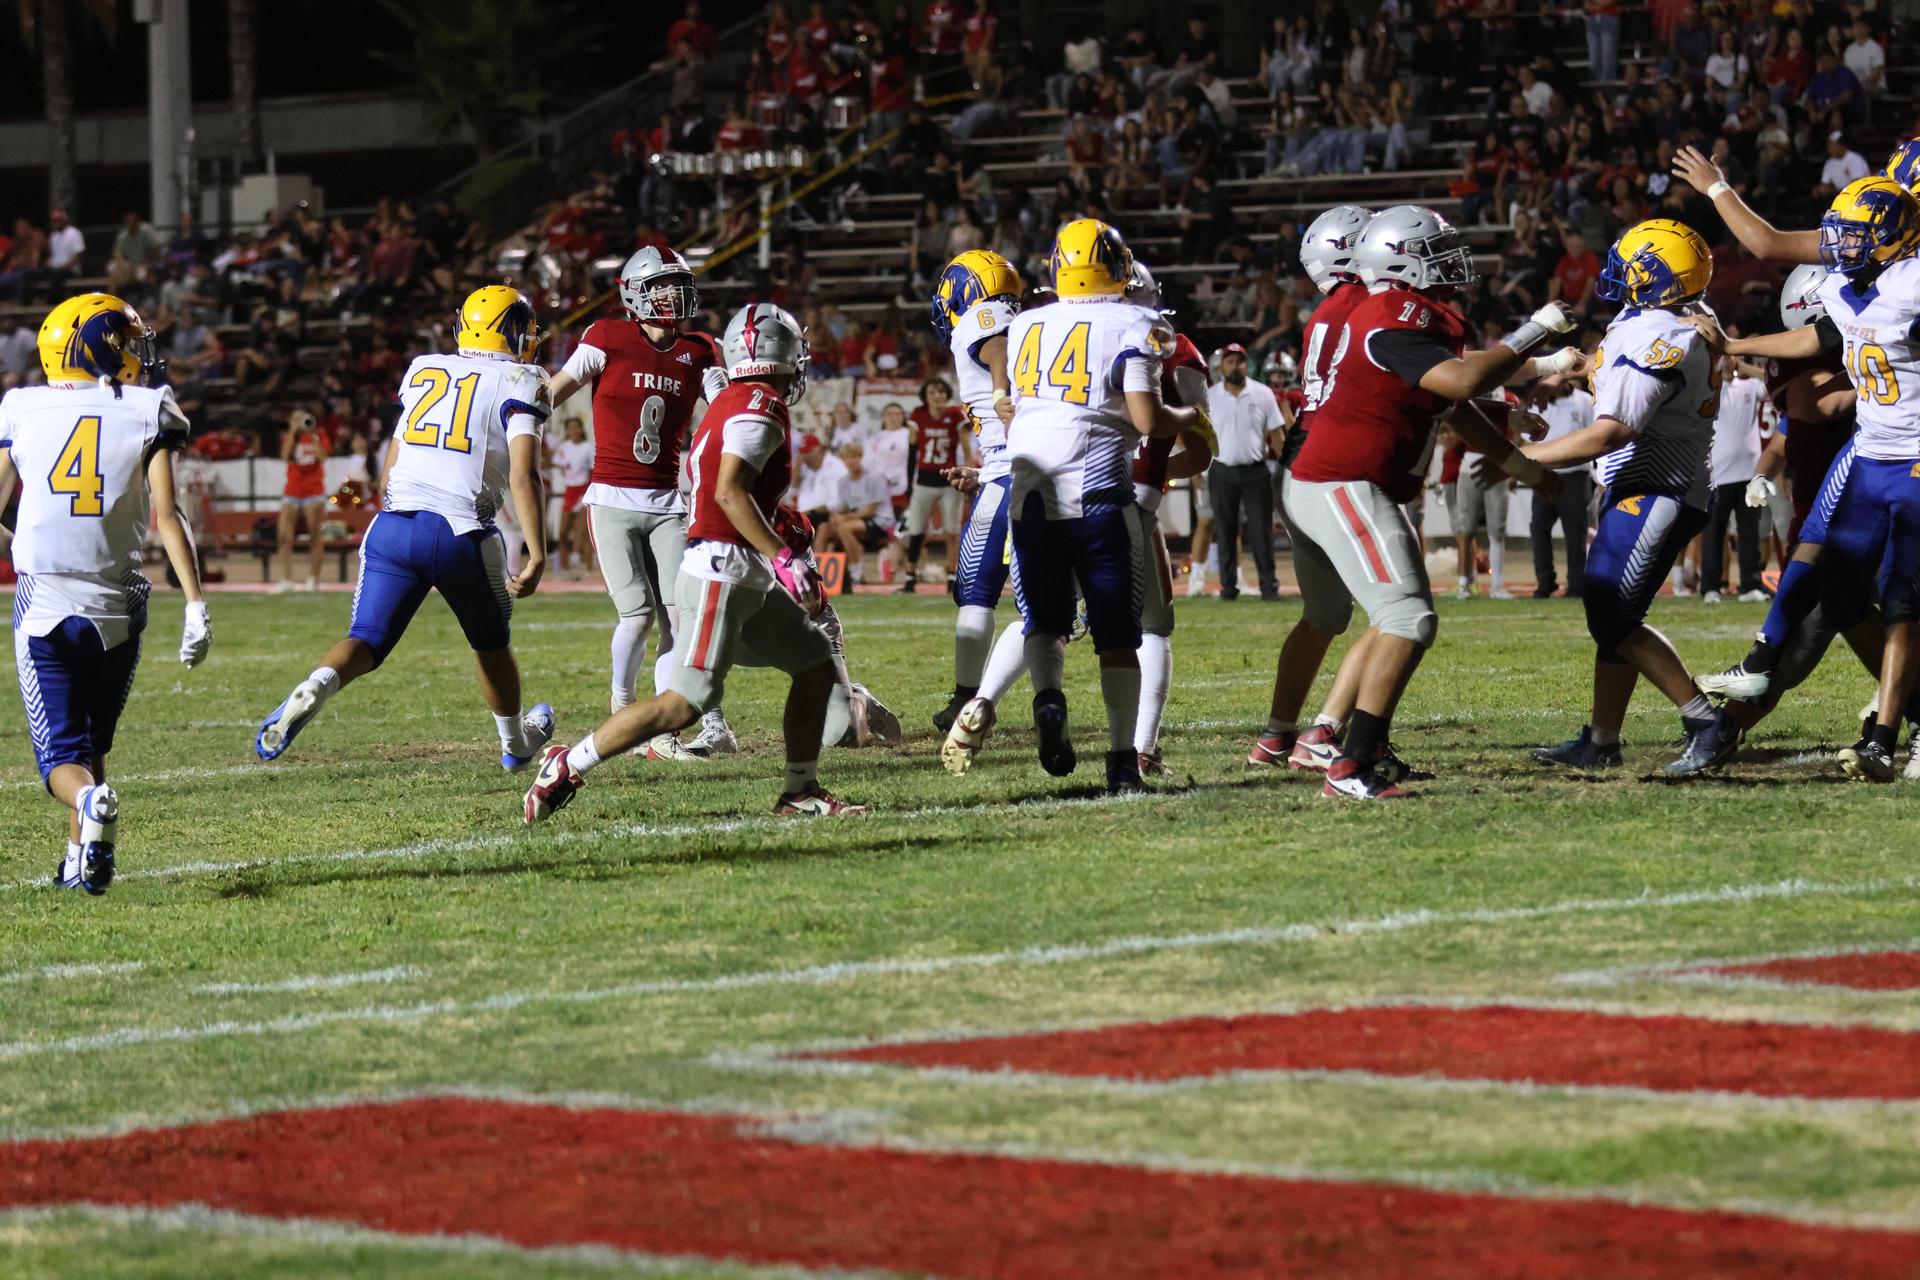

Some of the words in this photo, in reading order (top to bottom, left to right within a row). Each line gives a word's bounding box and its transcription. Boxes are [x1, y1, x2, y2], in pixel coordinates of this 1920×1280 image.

[977, 308, 996, 330] 6
[632, 372, 682, 396] TRIBE
[736, 364, 777, 376] Riddell
[1014, 322, 1092, 406] 44
[1846, 340, 1901, 406] 10
[403, 367, 482, 455] 21
[747, 389, 778, 413] 21
[633, 395, 666, 464] 8
[923, 438, 951, 464] 15
[47, 415, 104, 517] 4
